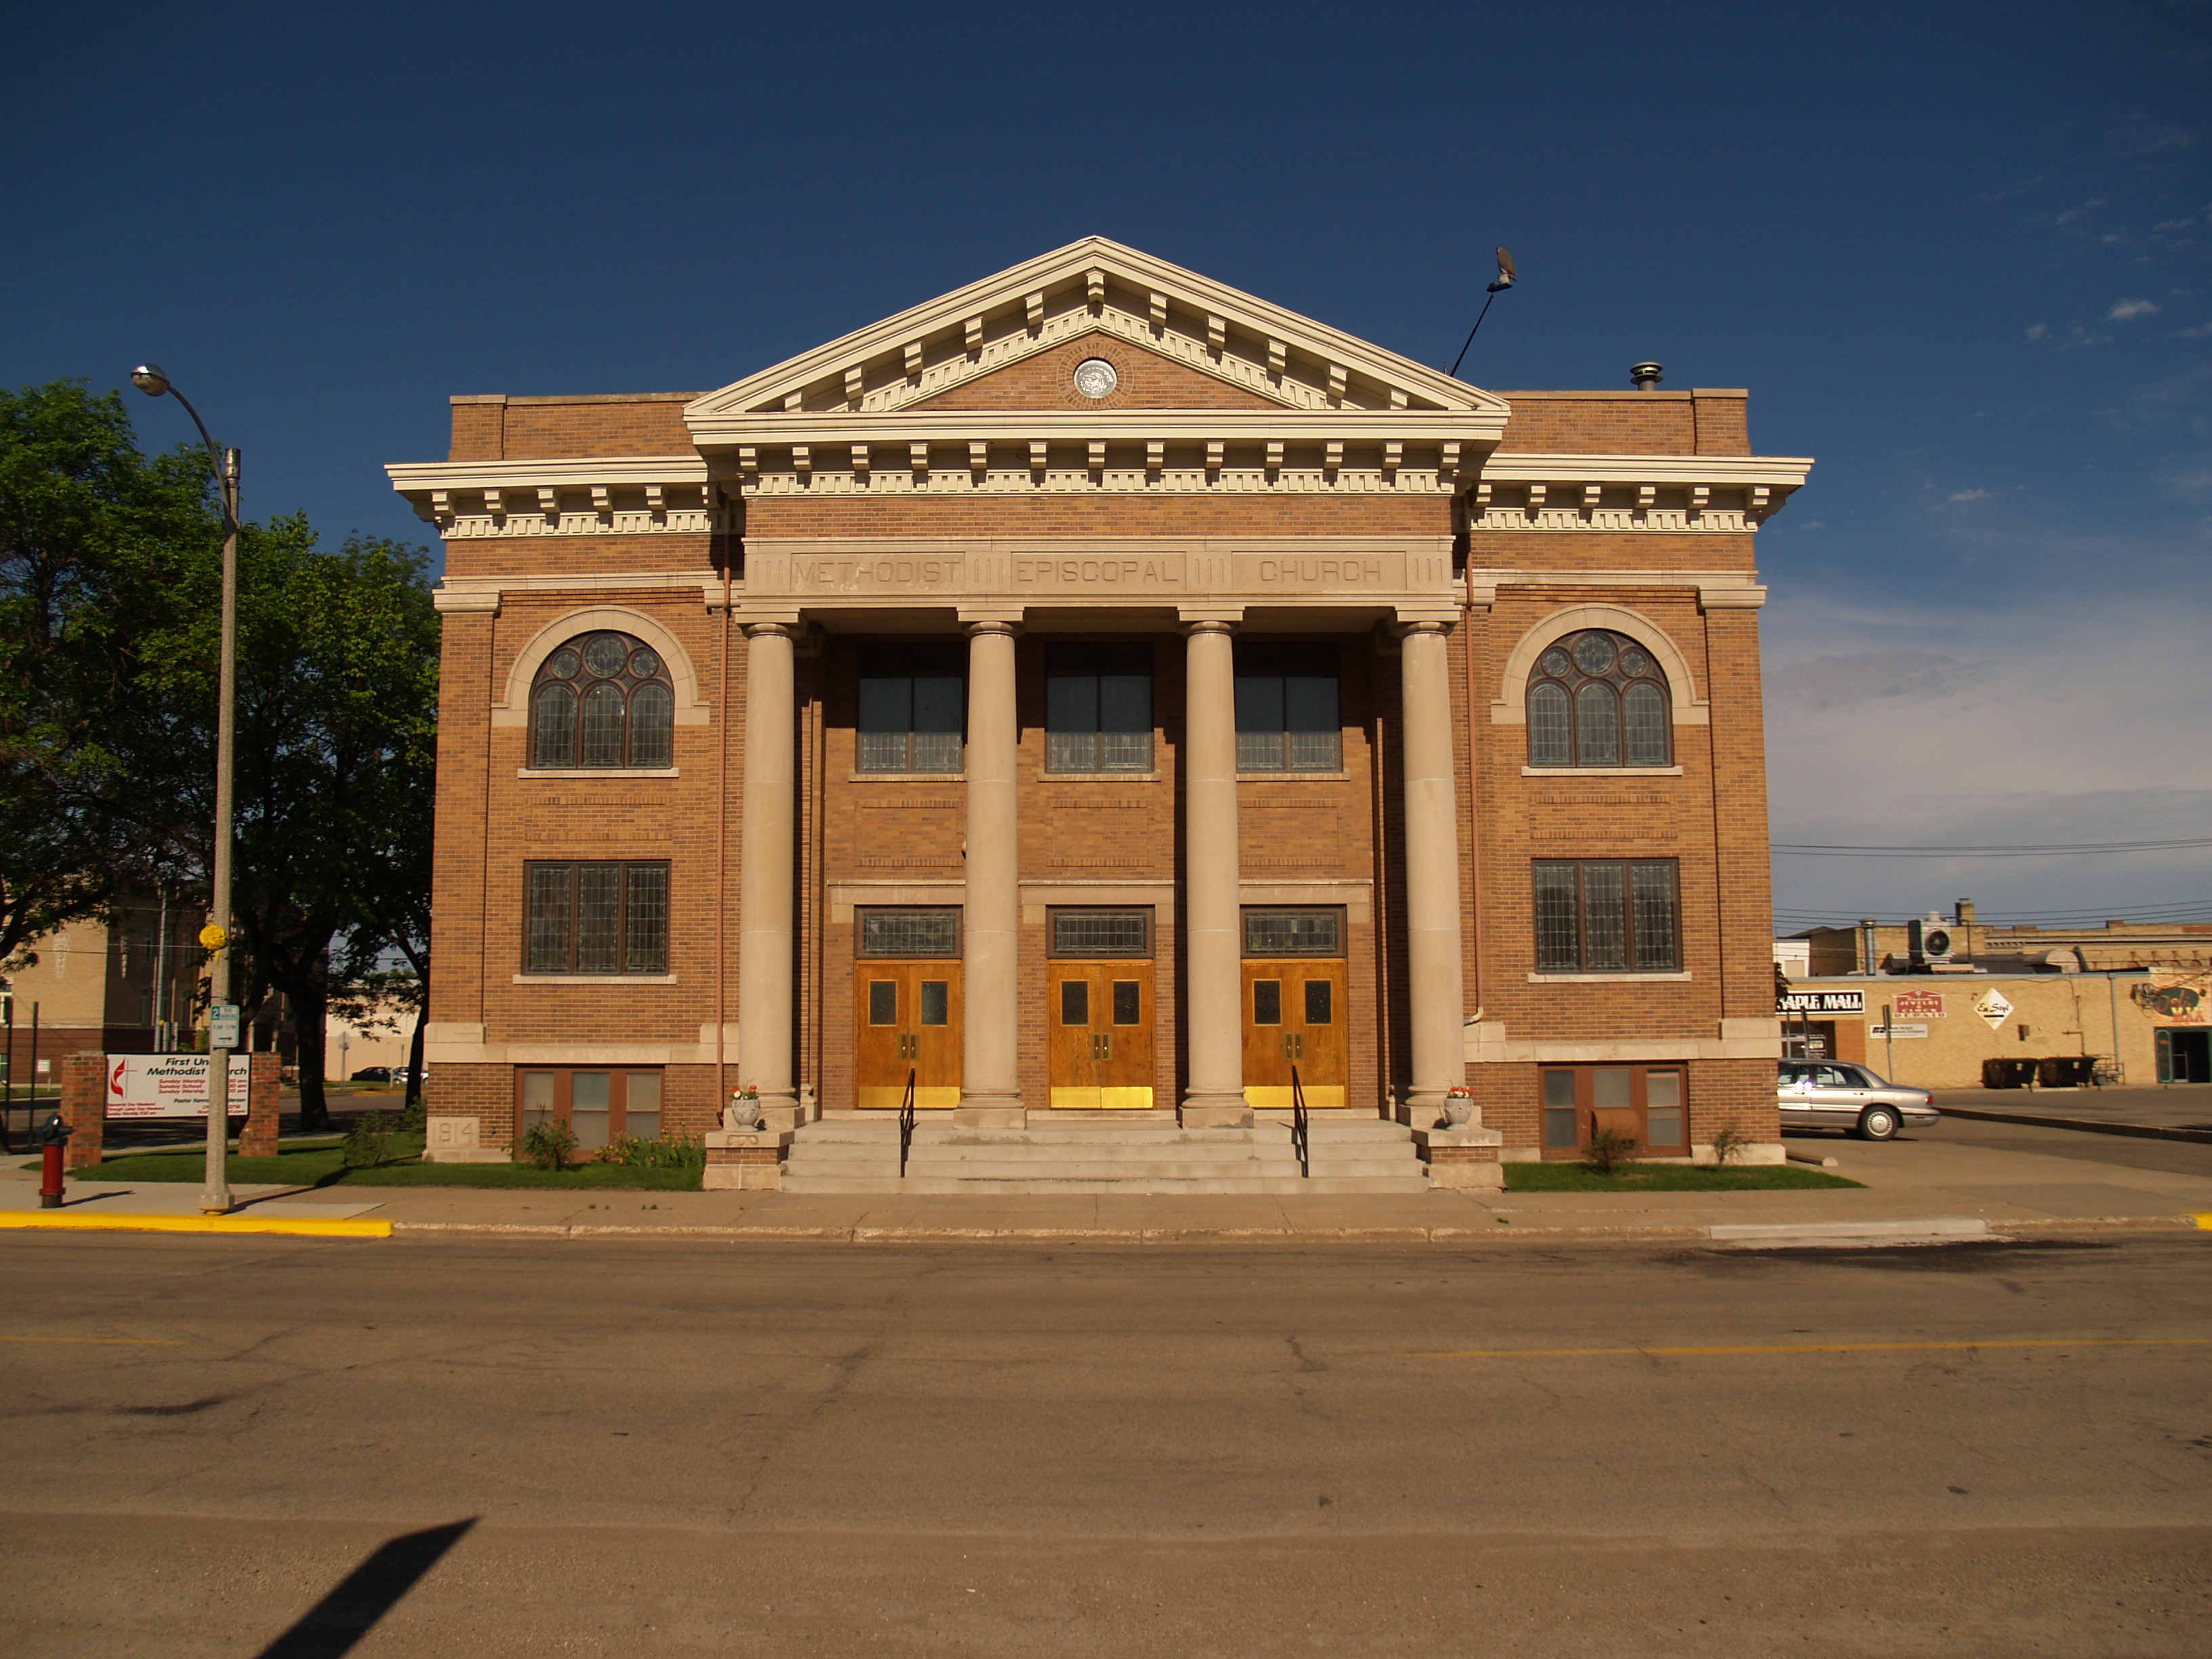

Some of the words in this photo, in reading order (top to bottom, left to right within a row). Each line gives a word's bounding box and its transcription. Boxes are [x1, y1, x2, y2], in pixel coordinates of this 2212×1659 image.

[795, 562, 961, 583] METHODIST
[1017, 561, 1179, 582] EPISCOPAL
[1259, 560, 1381, 582] CHURCH
[1823, 994, 1862, 1009] MALL
[212, 1008, 219, 1019] 2
[146, 1067, 206, 1076] Methodist
[432, 1122, 474, 1143] 1914
